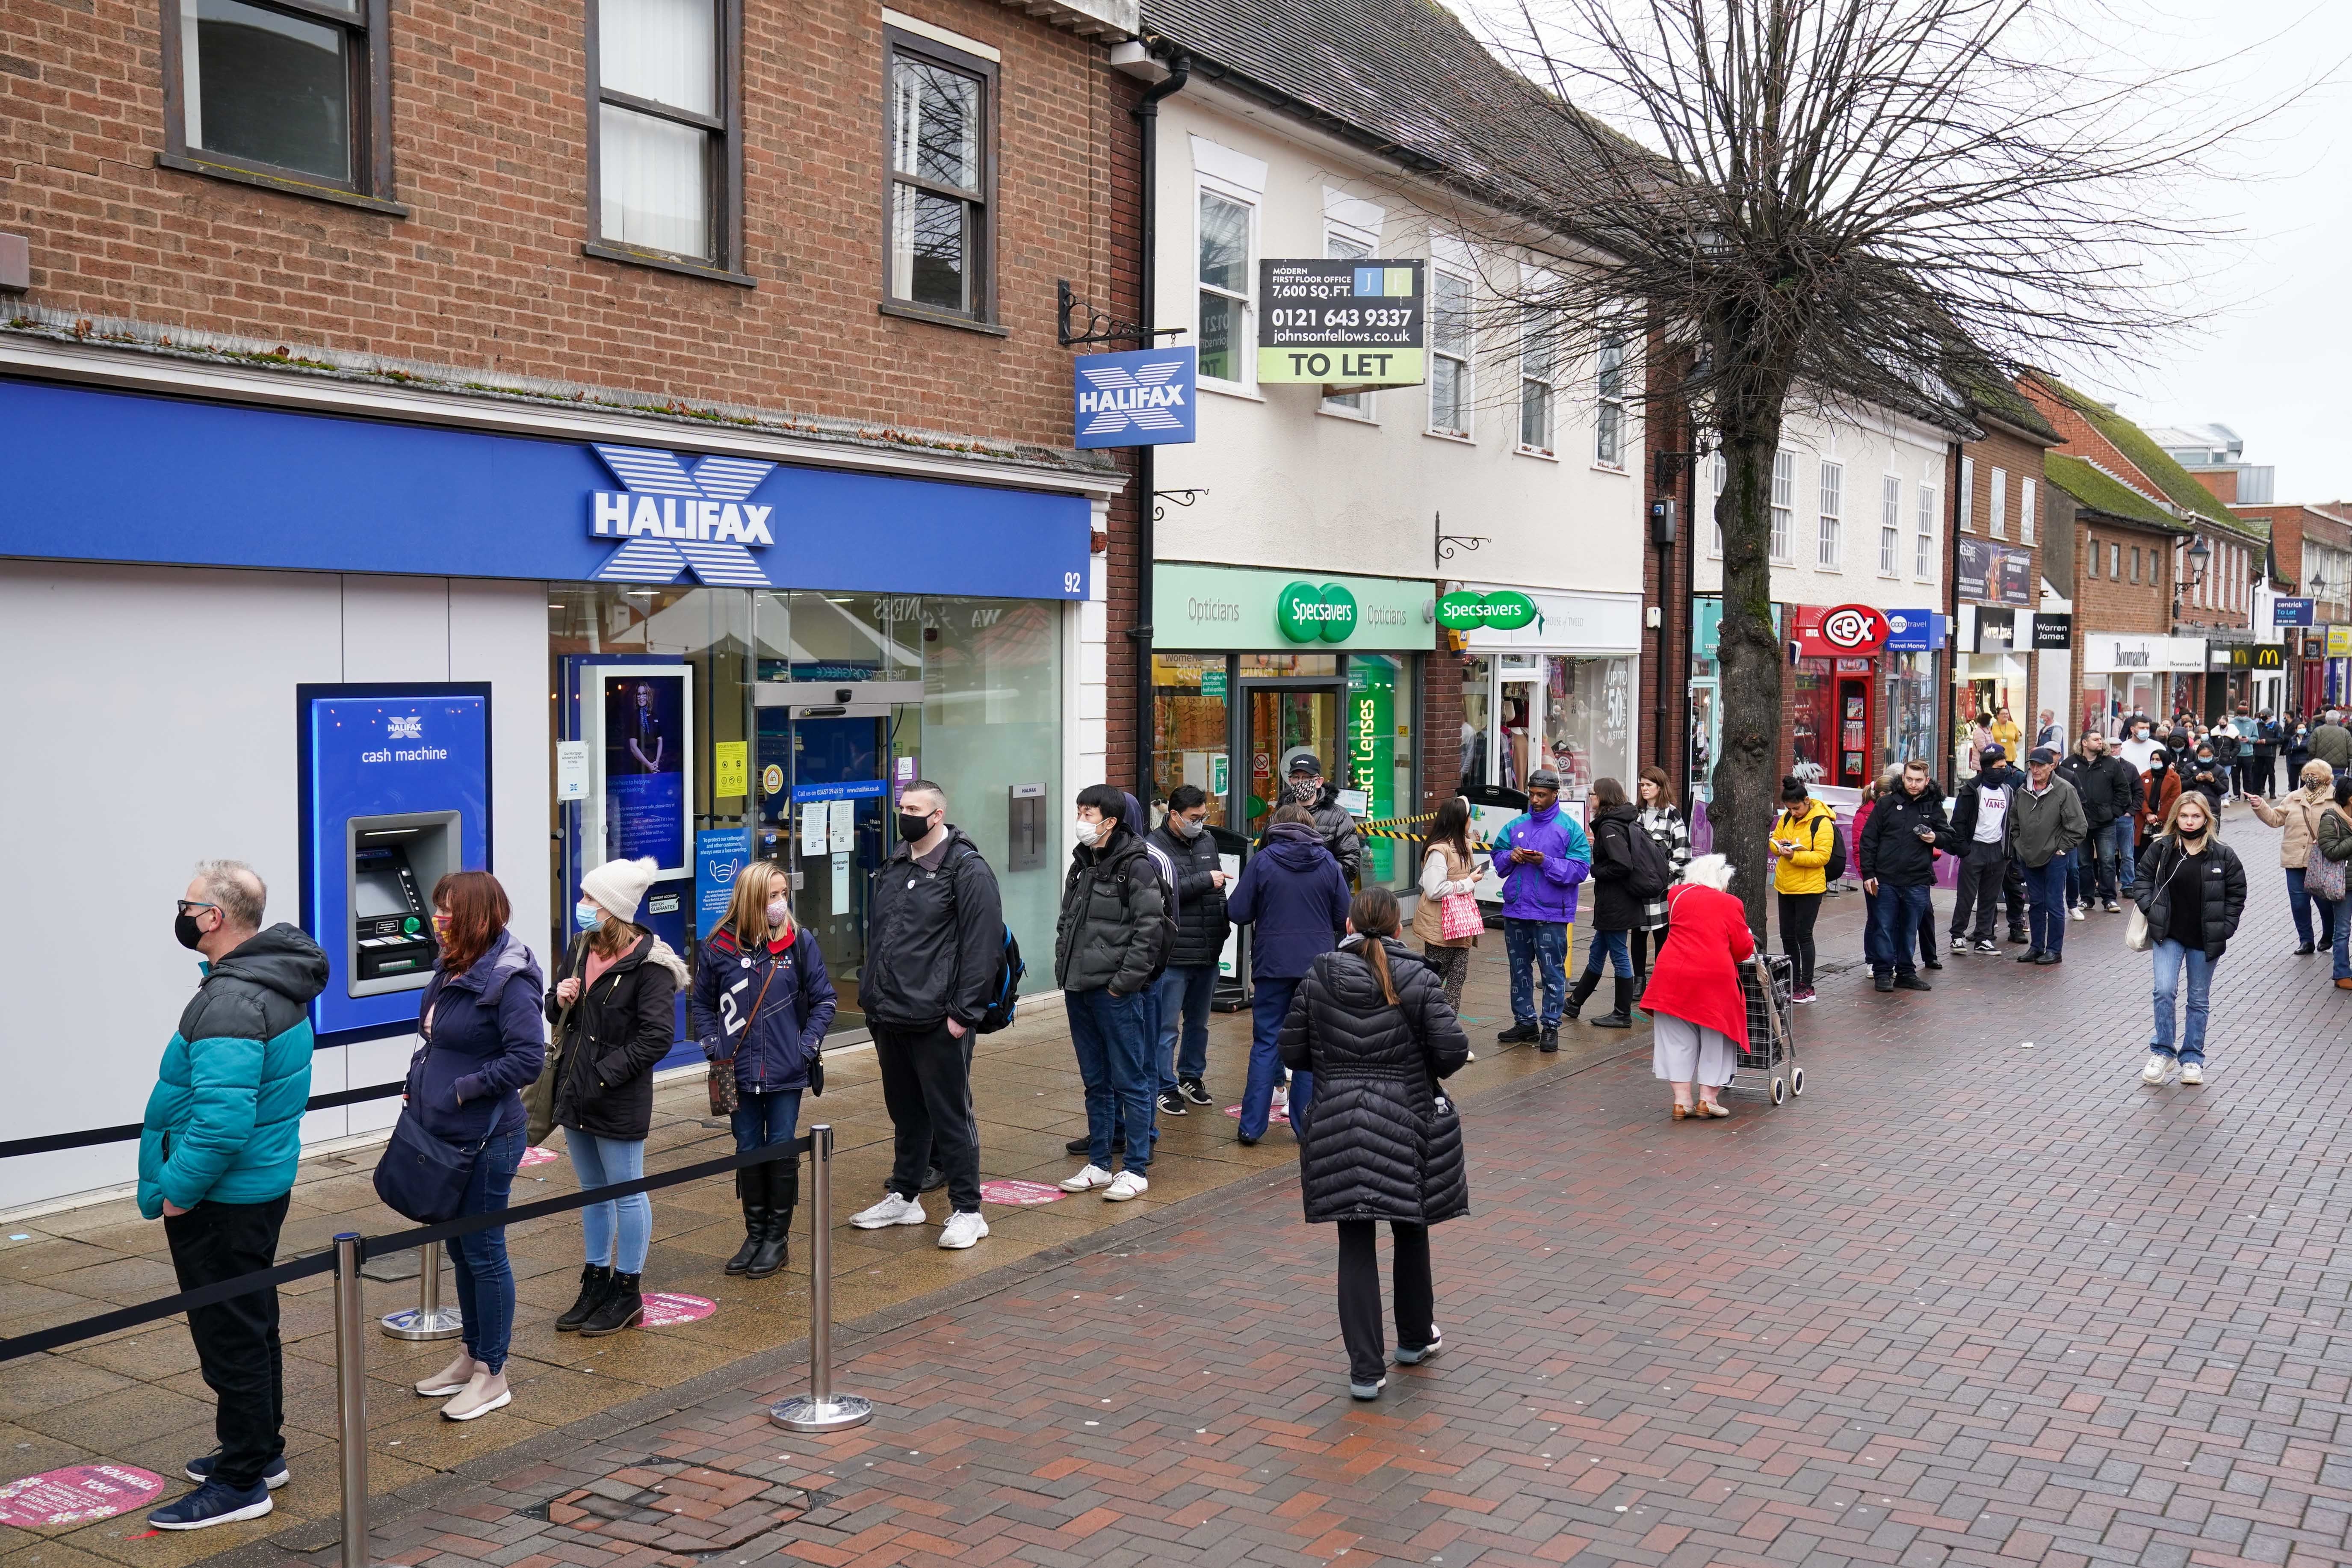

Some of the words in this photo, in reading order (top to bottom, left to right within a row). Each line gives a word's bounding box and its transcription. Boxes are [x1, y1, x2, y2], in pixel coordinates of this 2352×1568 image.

[1365, 273, 1372, 291] J
[1273, 286, 1307, 298] 7,600
[1310, 286, 1351, 299] SQ.FT.
[1272, 309, 1316, 326] 0121
[1324, 309, 1359, 326] 643
[1365, 309, 1412, 326] 9337
[1273, 329, 1410, 344] johnsonfellows.co.uk
[1288, 353, 1330, 376] TO
[1343, 354, 1393, 375] LET
[1080, 384, 1185, 413] HALIFAX
[595, 492, 774, 545] HALIFAX
[1064, 572, 1081, 593] 92
[1188, 597, 1239, 625] Opticians
[1293, 598, 1351, 625] Specsavers
[1367, 604, 1406, 629] Opticians
[1443, 602, 1521, 620] Specsavers
[1546, 616, 1561, 626] HOUSE
[1568, 617, 1584, 626] TWEED
[2038, 632, 2064, 640] James
[2115, 643, 2149, 667] Bonmarché
[1607, 671, 1616, 686] UP
[1618, 670, 1627, 685] TO
[1607, 687, 1622, 728] 50
[387, 723, 422, 732] HALIFAX
[1356, 700, 1374, 761] Lenses
[1612, 730, 1626, 739] STORE
[362, 748, 391, 763] cash
[396, 746, 447, 761] machine
[1010, 1180, 1060, 1191] SOLIHULL
[655, 1293, 711, 1306] SOLIHULL
[95, 1465, 158, 1490] SOLIHULL
[20, 1494, 53, 1506] DINING
[38, 1483, 80, 1500] SHOPPING
[45, 1494, 82, 1509] MEETING
